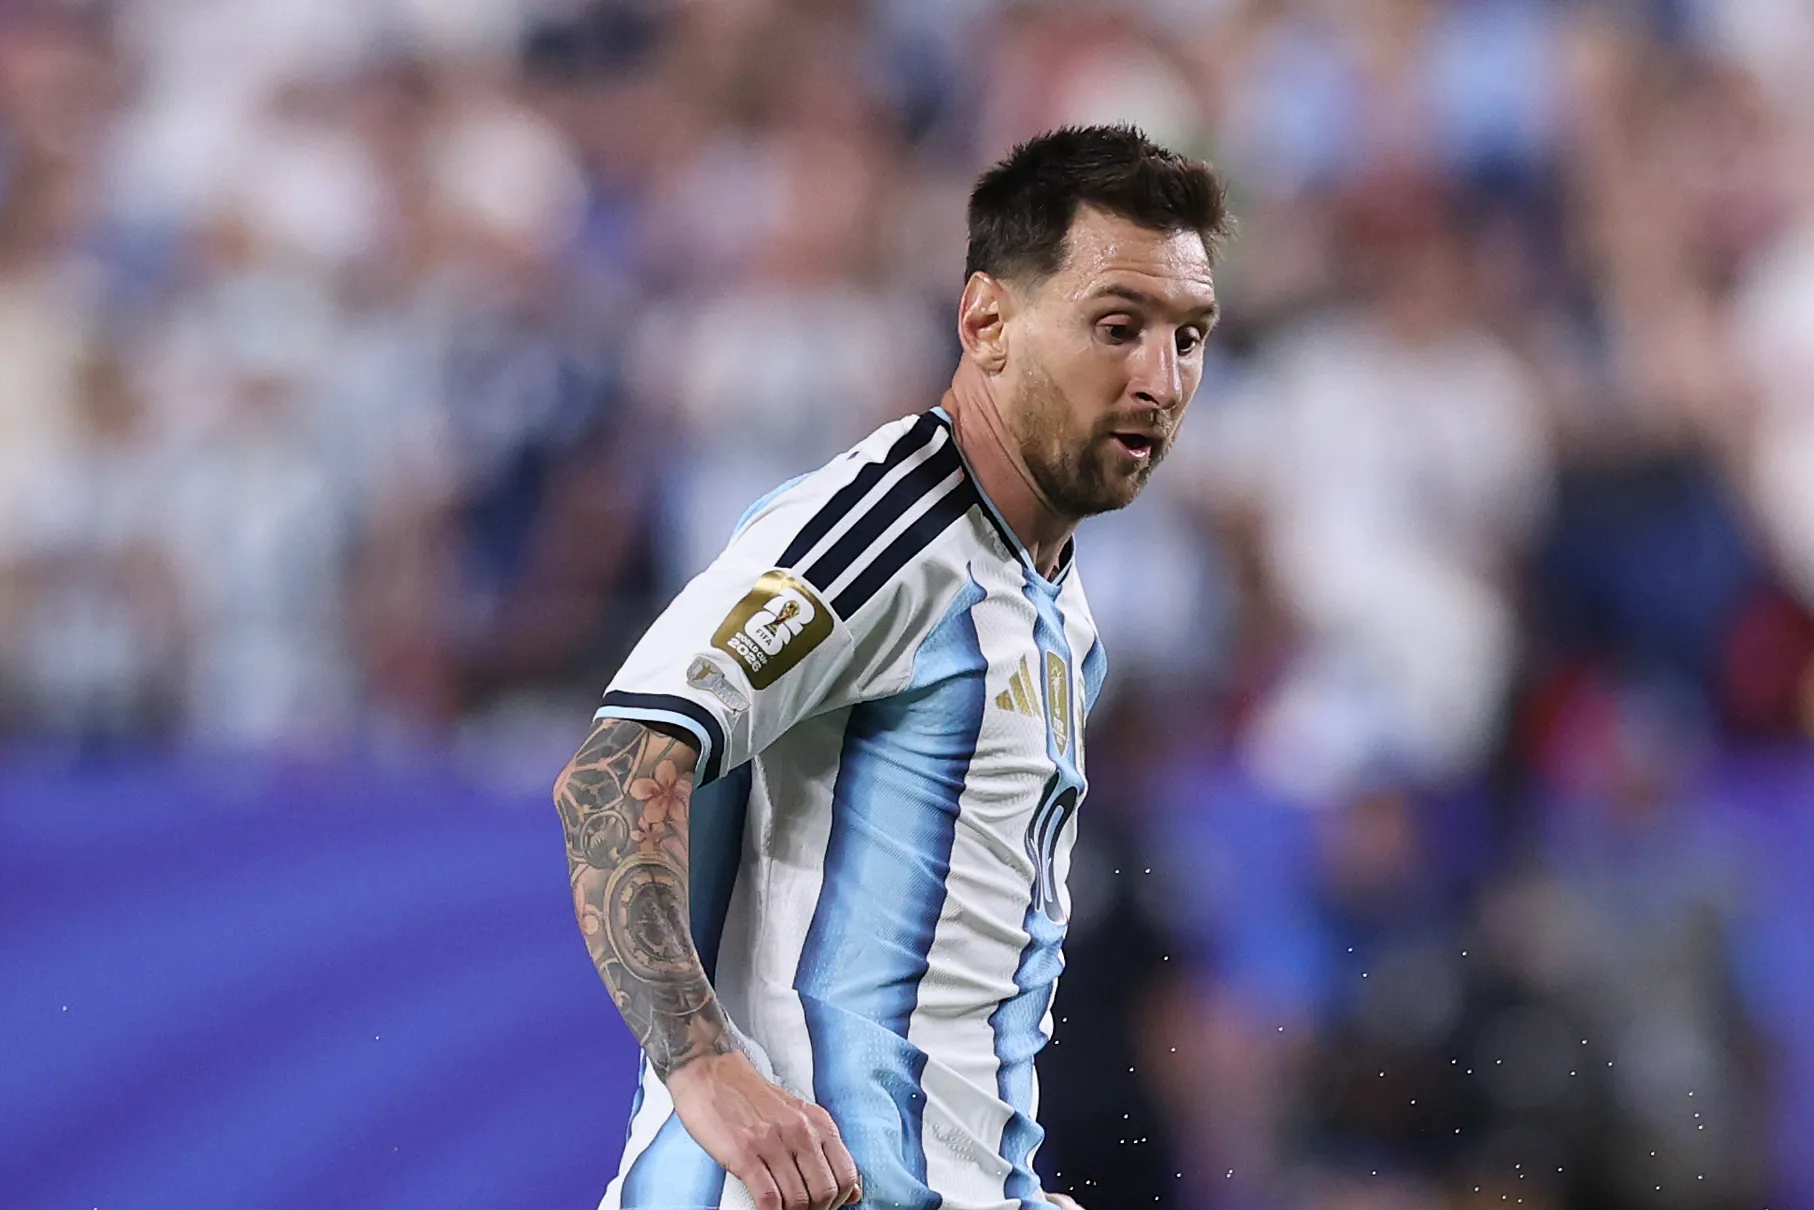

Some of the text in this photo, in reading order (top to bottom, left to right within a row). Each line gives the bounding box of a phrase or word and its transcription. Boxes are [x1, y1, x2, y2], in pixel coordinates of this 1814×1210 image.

[735, 632, 768, 664] WORLD CUP
[756, 628, 772, 646] FIFA
[727, 637, 761, 672] 2026
